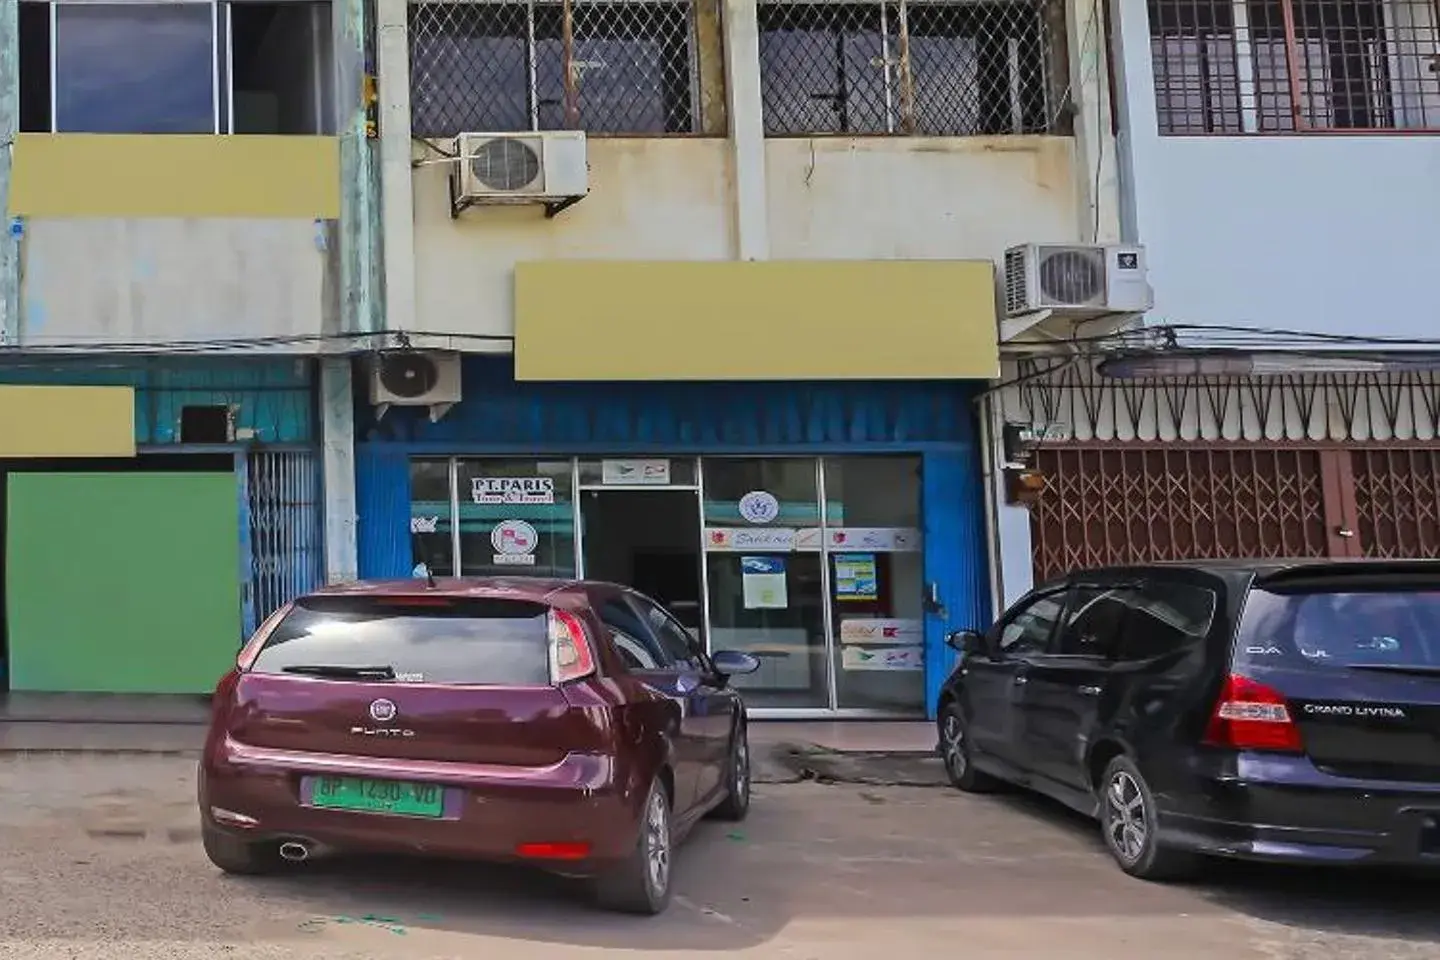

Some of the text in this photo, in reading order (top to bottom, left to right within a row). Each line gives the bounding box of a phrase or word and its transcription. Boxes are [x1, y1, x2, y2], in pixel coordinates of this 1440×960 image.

[475, 479, 552, 490] PT.PARIS
[1304, 704, 1405, 718] GRAND LIVINA
